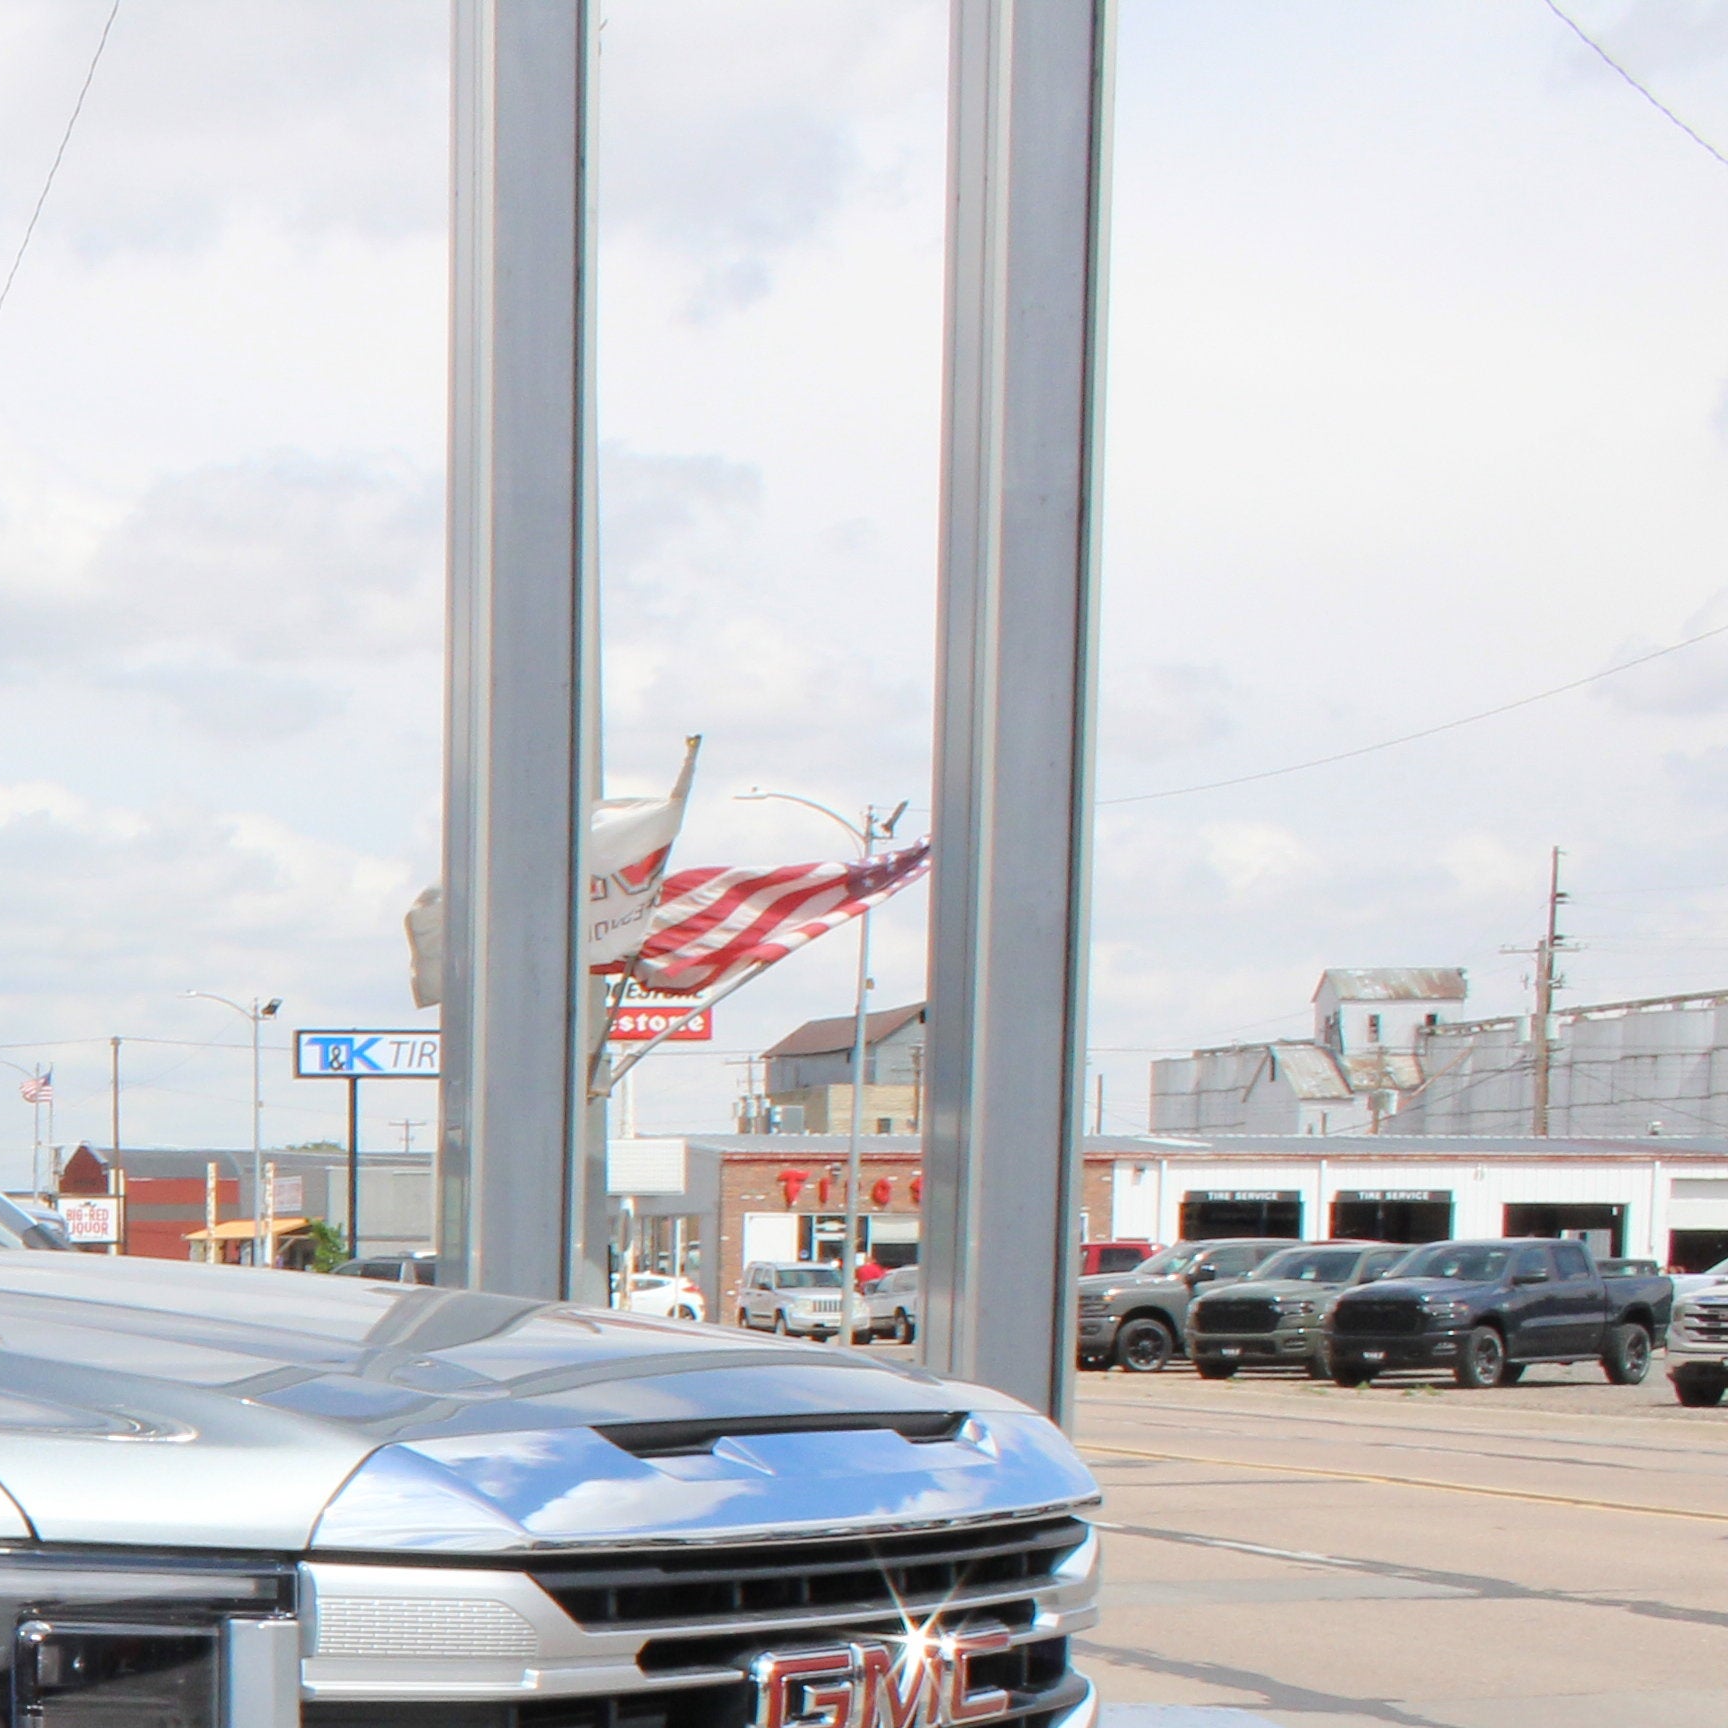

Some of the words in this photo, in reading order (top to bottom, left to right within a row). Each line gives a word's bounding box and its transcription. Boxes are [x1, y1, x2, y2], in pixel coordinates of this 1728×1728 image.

[305, 1037, 384, 1071] T&K
[389, 1040, 438, 1068] TIR
[1208, 1192, 1230, 1200] TIRE
[1235, 1192, 1278, 1200] SERVICE
[1357, 1191, 1381, 1200] TIRE
[1385, 1191, 1430, 1200] SERVICE
